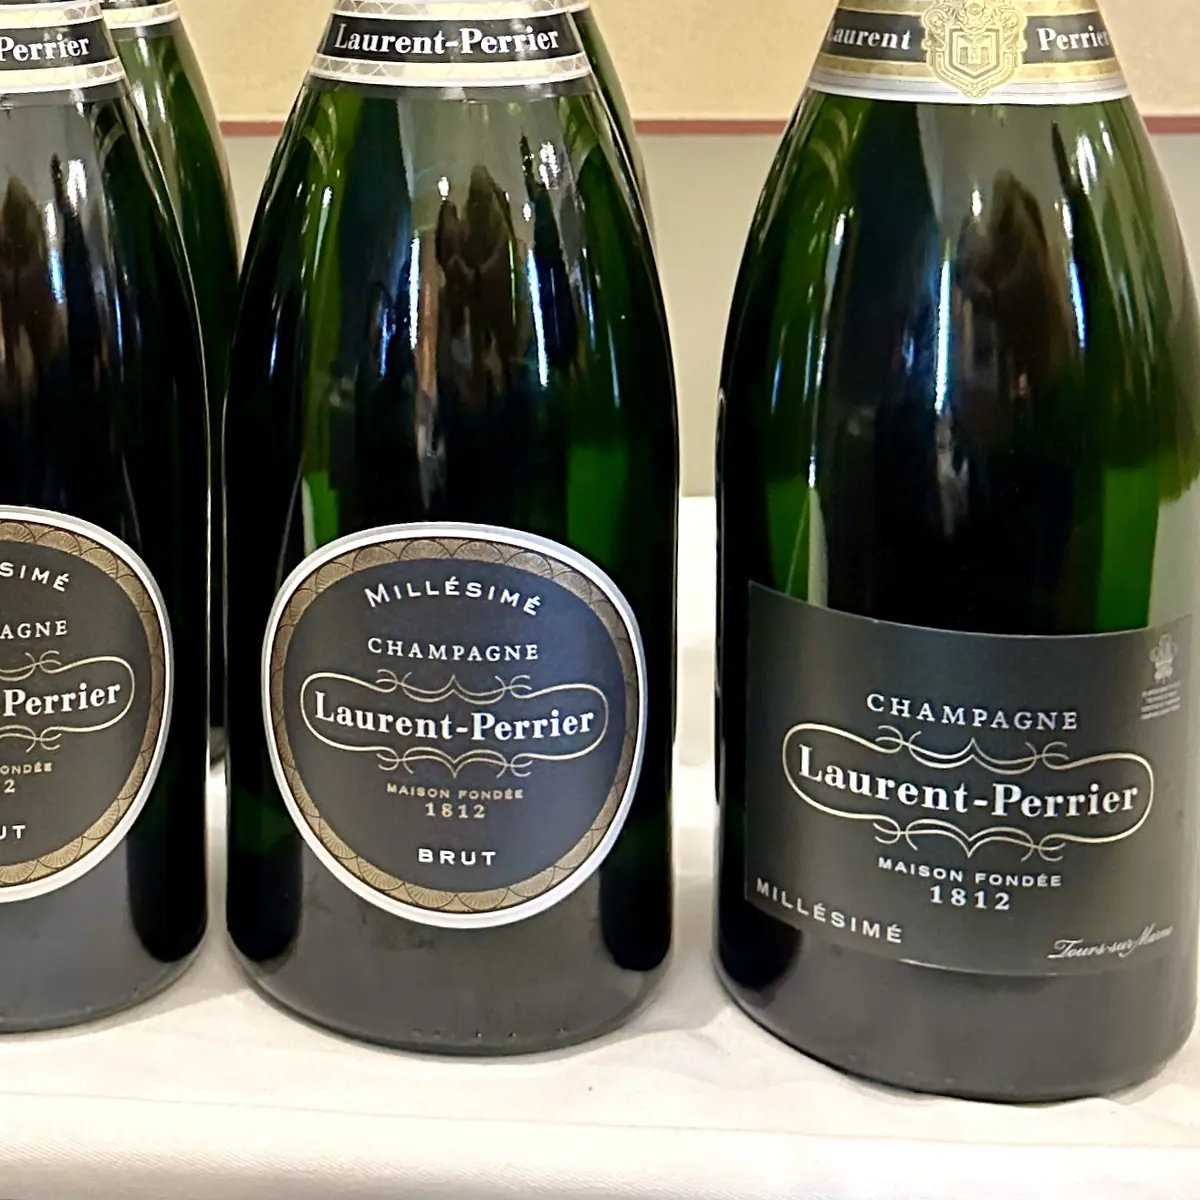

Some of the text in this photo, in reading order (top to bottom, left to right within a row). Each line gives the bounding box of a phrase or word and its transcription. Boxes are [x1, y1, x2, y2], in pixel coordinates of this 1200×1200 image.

[333, 22, 560, 56] Laurent-Perrier
[363, 575, 542, 617] MILLÉSIMÉ
[367, 636, 540, 662] CHAMPAGNE
[313, 690, 596, 742] Laurent-Perrier
[866, 692, 1079, 731] CHAMPAGNE
[386, 782, 525, 801] MAISON FONDÉE
[798, 743, 1140, 819] Laurent-Perrier
[424, 801, 486, 819] 1812
[417, 847, 497, 867] BRUT
[877, 855, 1063, 888] MAISON FONDÉE
[756, 877, 903, 945] MILLÉSIMÉ
[928, 885, 1011, 912] 1812
